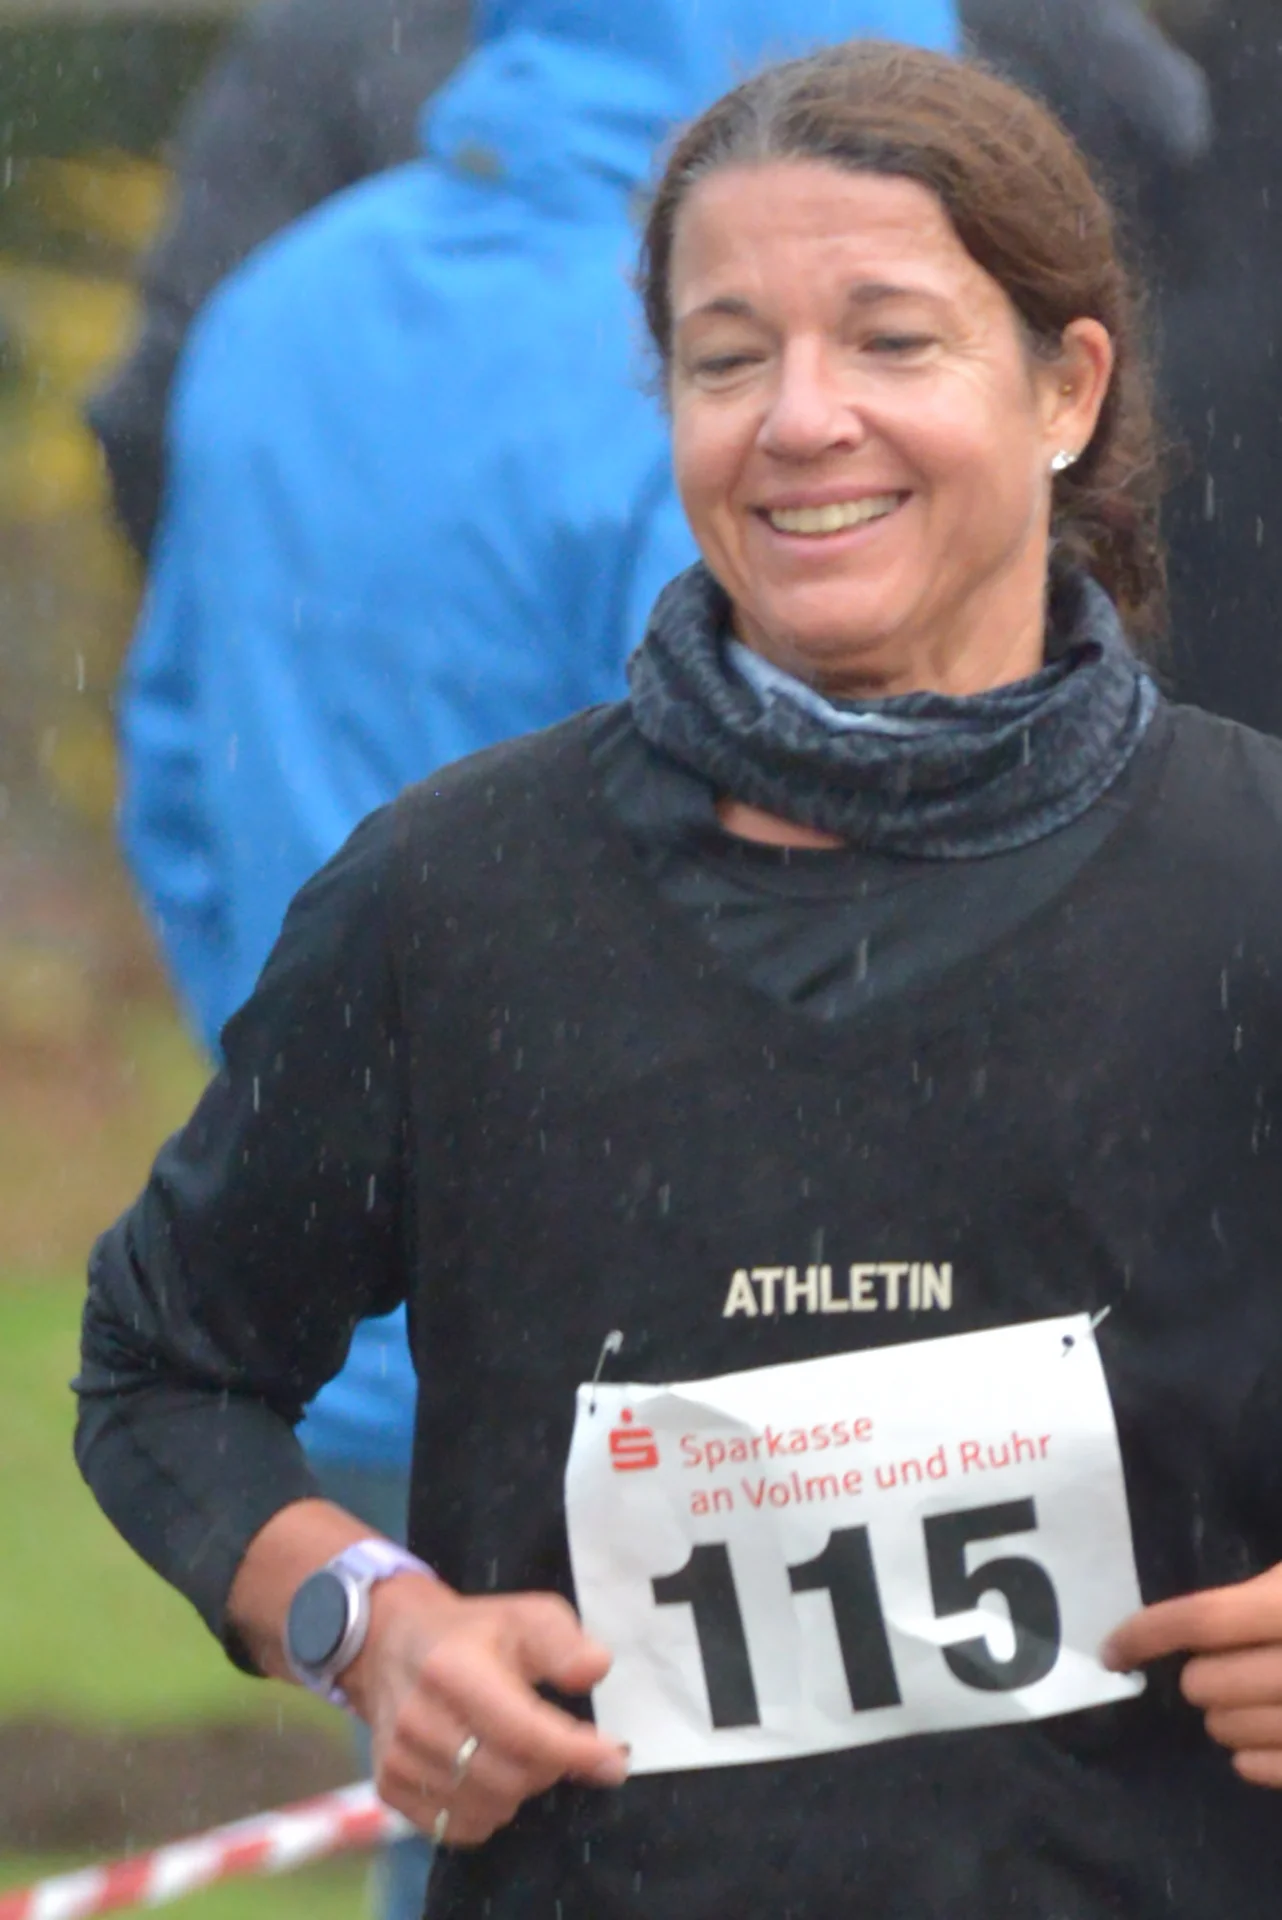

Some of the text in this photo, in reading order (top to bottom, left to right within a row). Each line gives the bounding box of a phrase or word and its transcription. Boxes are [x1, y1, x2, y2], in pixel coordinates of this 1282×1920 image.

[722, 1262, 953, 1318] ATHLETIN
[680, 1415, 873, 1473] Sparkasse
[690, 1431, 1052, 1517] an Volme und Ruhr
[651, 1494, 1063, 1731] 115
